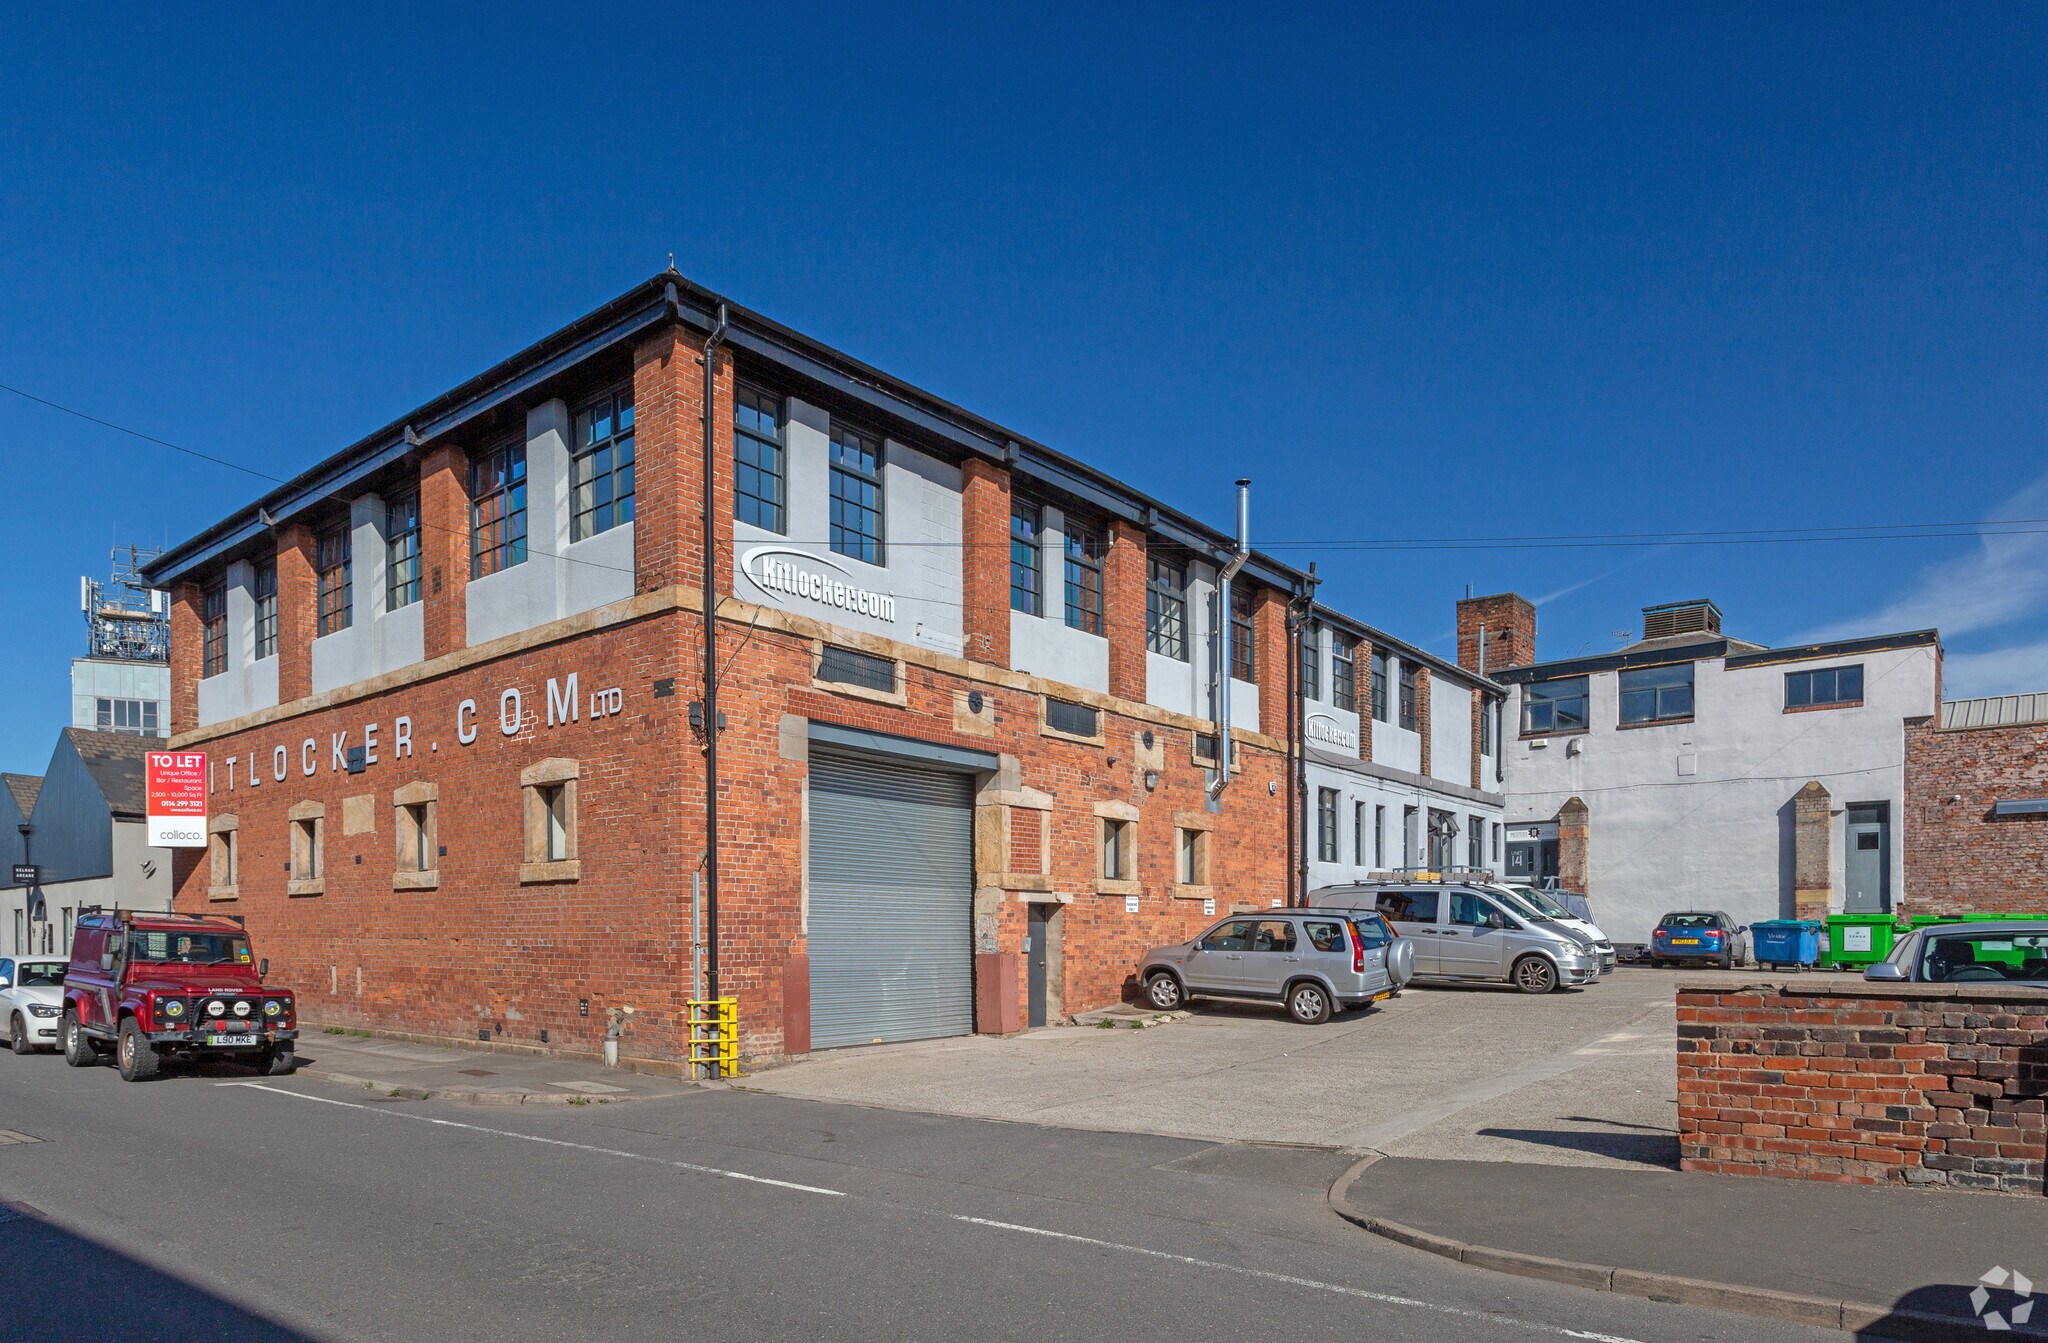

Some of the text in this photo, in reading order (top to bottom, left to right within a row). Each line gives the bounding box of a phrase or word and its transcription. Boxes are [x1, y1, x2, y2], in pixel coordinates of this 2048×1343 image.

[762, 555, 895, 623] Kitlocker.com
[210, 672, 623, 795] ITLOCKER.COM LTD
[152, 755, 202, 768] TO LET
[1511, 855, 1523, 867] 14
[217, 1036, 252, 1044] L90 MKE
